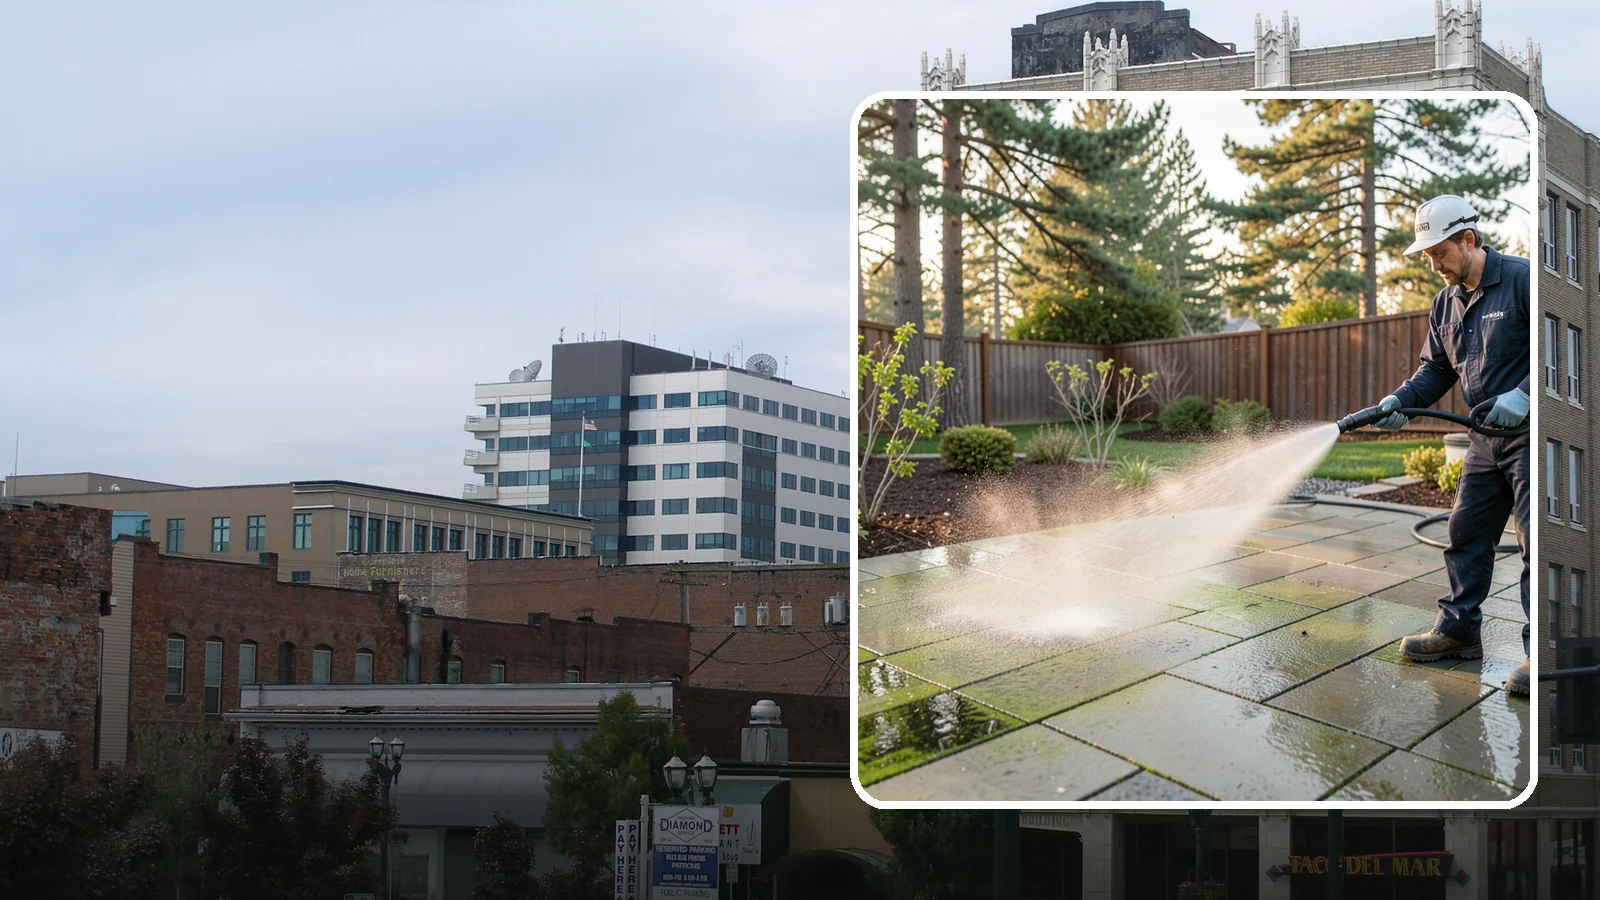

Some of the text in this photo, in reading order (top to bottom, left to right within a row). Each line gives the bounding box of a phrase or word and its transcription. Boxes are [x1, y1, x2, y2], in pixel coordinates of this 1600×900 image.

[370, 566, 427, 577] Furnishers
[660, 818, 713, 832] DIAMOND
[1021, 815, 1070, 828] BUILDING
[719, 824, 740, 835] ETT
[656, 845, 716, 854] RESERVED PARKING
[617, 824, 625, 893] PAY HERE
[628, 824, 636, 893] PAY HERE
[671, 862, 701, 870] PATRONS
[1346, 857, 1384, 875] DEL
[1392, 857, 1442, 877] MAR
[660, 889, 710, 898] PUBLIC PARKING
